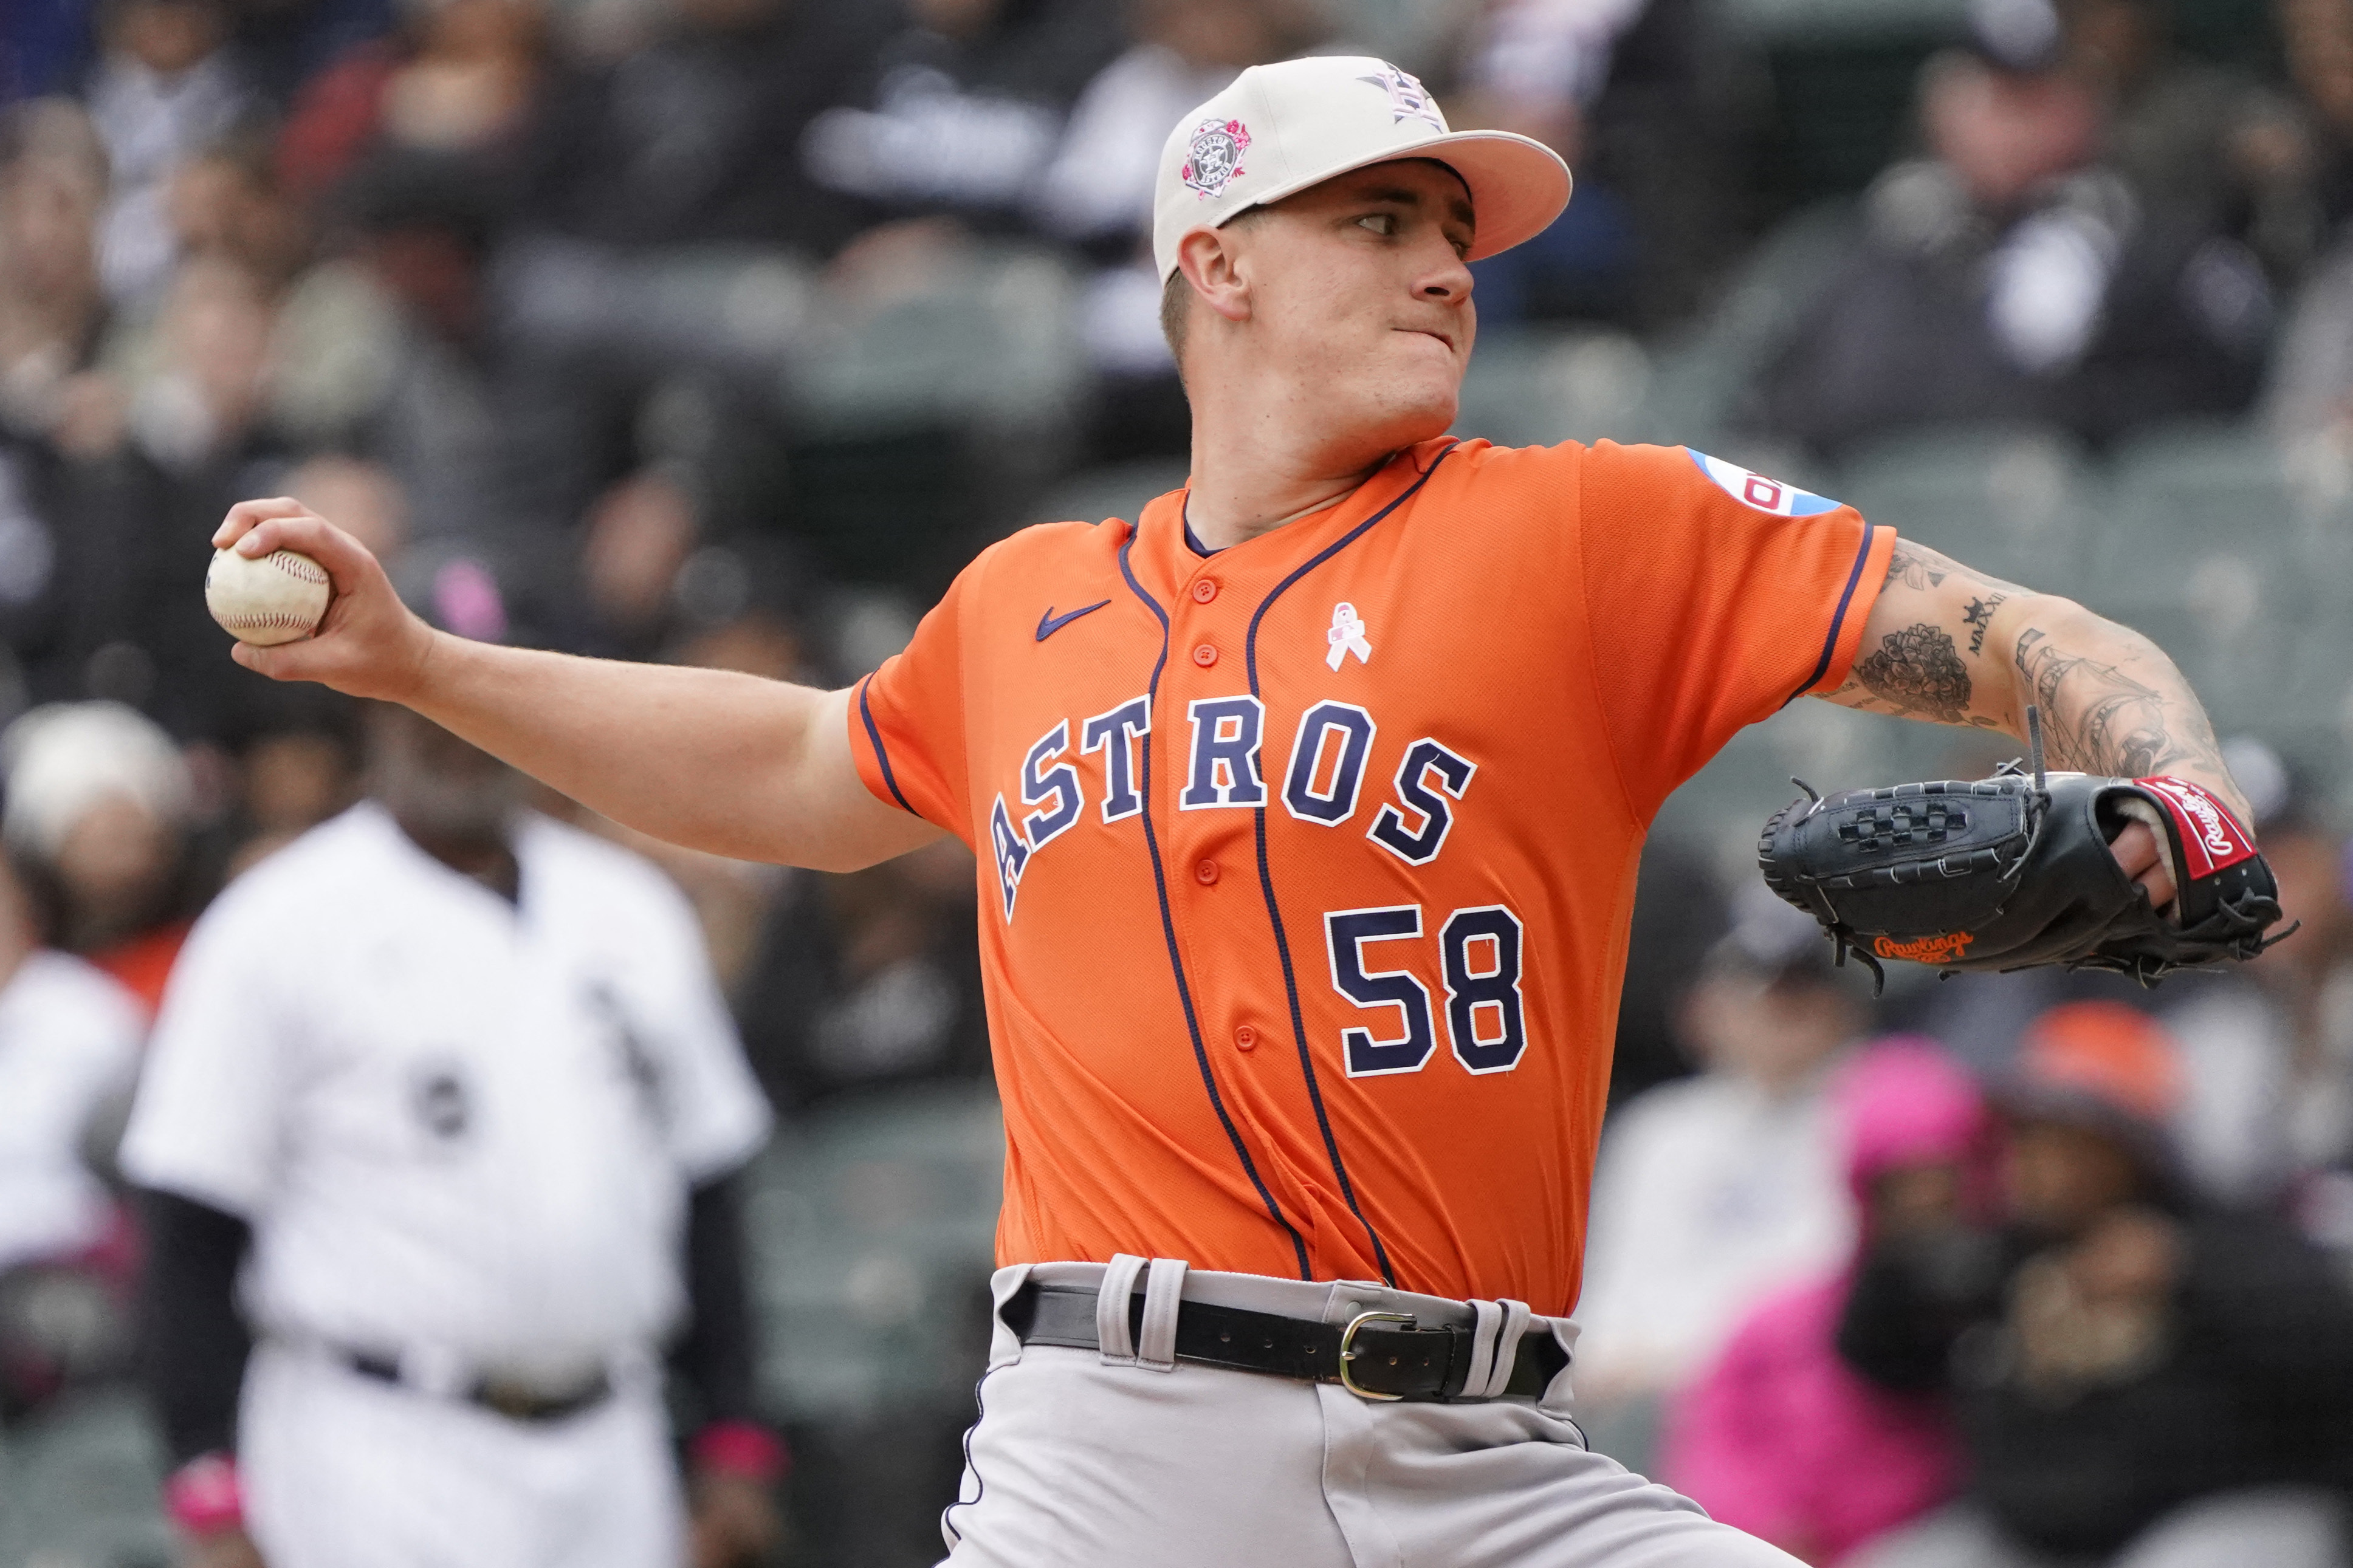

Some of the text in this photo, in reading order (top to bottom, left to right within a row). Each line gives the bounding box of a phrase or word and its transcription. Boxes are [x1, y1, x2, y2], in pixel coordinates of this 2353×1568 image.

[990, 693, 1478, 925] ASTROS
[1324, 904, 1528, 1078] 58
[1874, 931, 1974, 963] Rawlings
